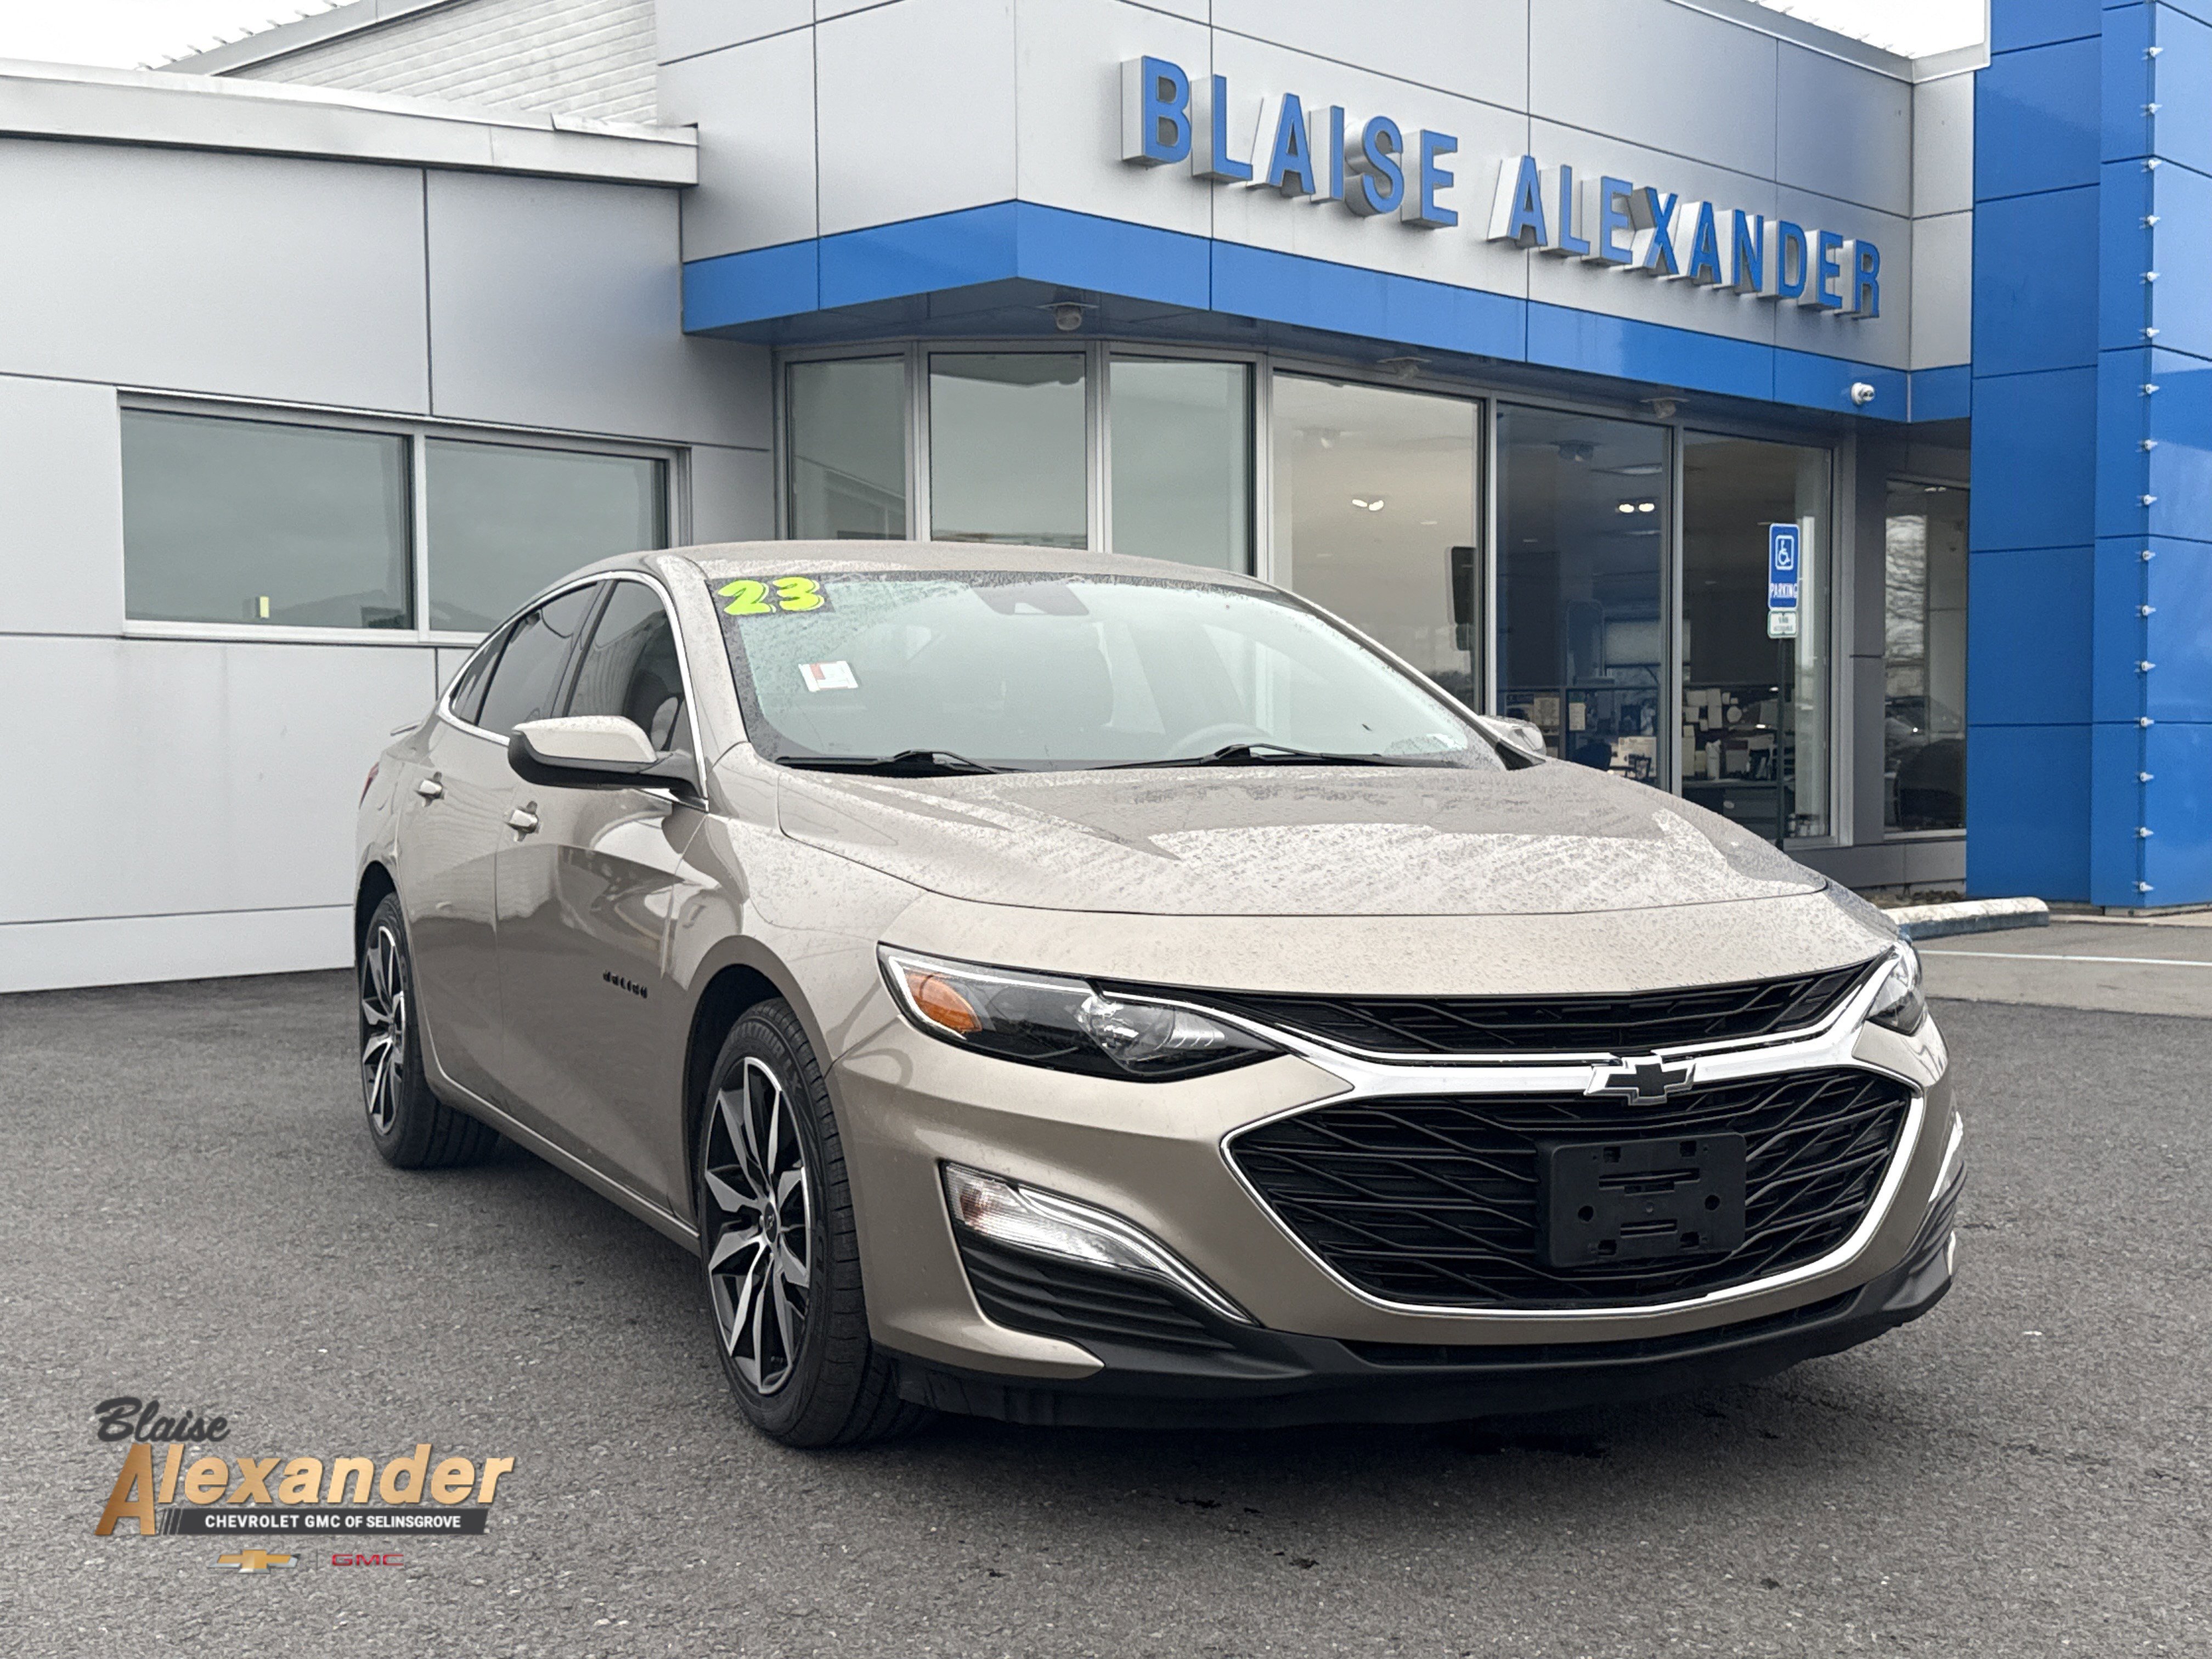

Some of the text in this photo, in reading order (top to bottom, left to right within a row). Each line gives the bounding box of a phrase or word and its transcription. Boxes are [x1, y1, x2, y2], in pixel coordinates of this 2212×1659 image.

[1121, 55, 1881, 319] BLAISE ALEXANDER
[718, 577, 825, 615] 23
